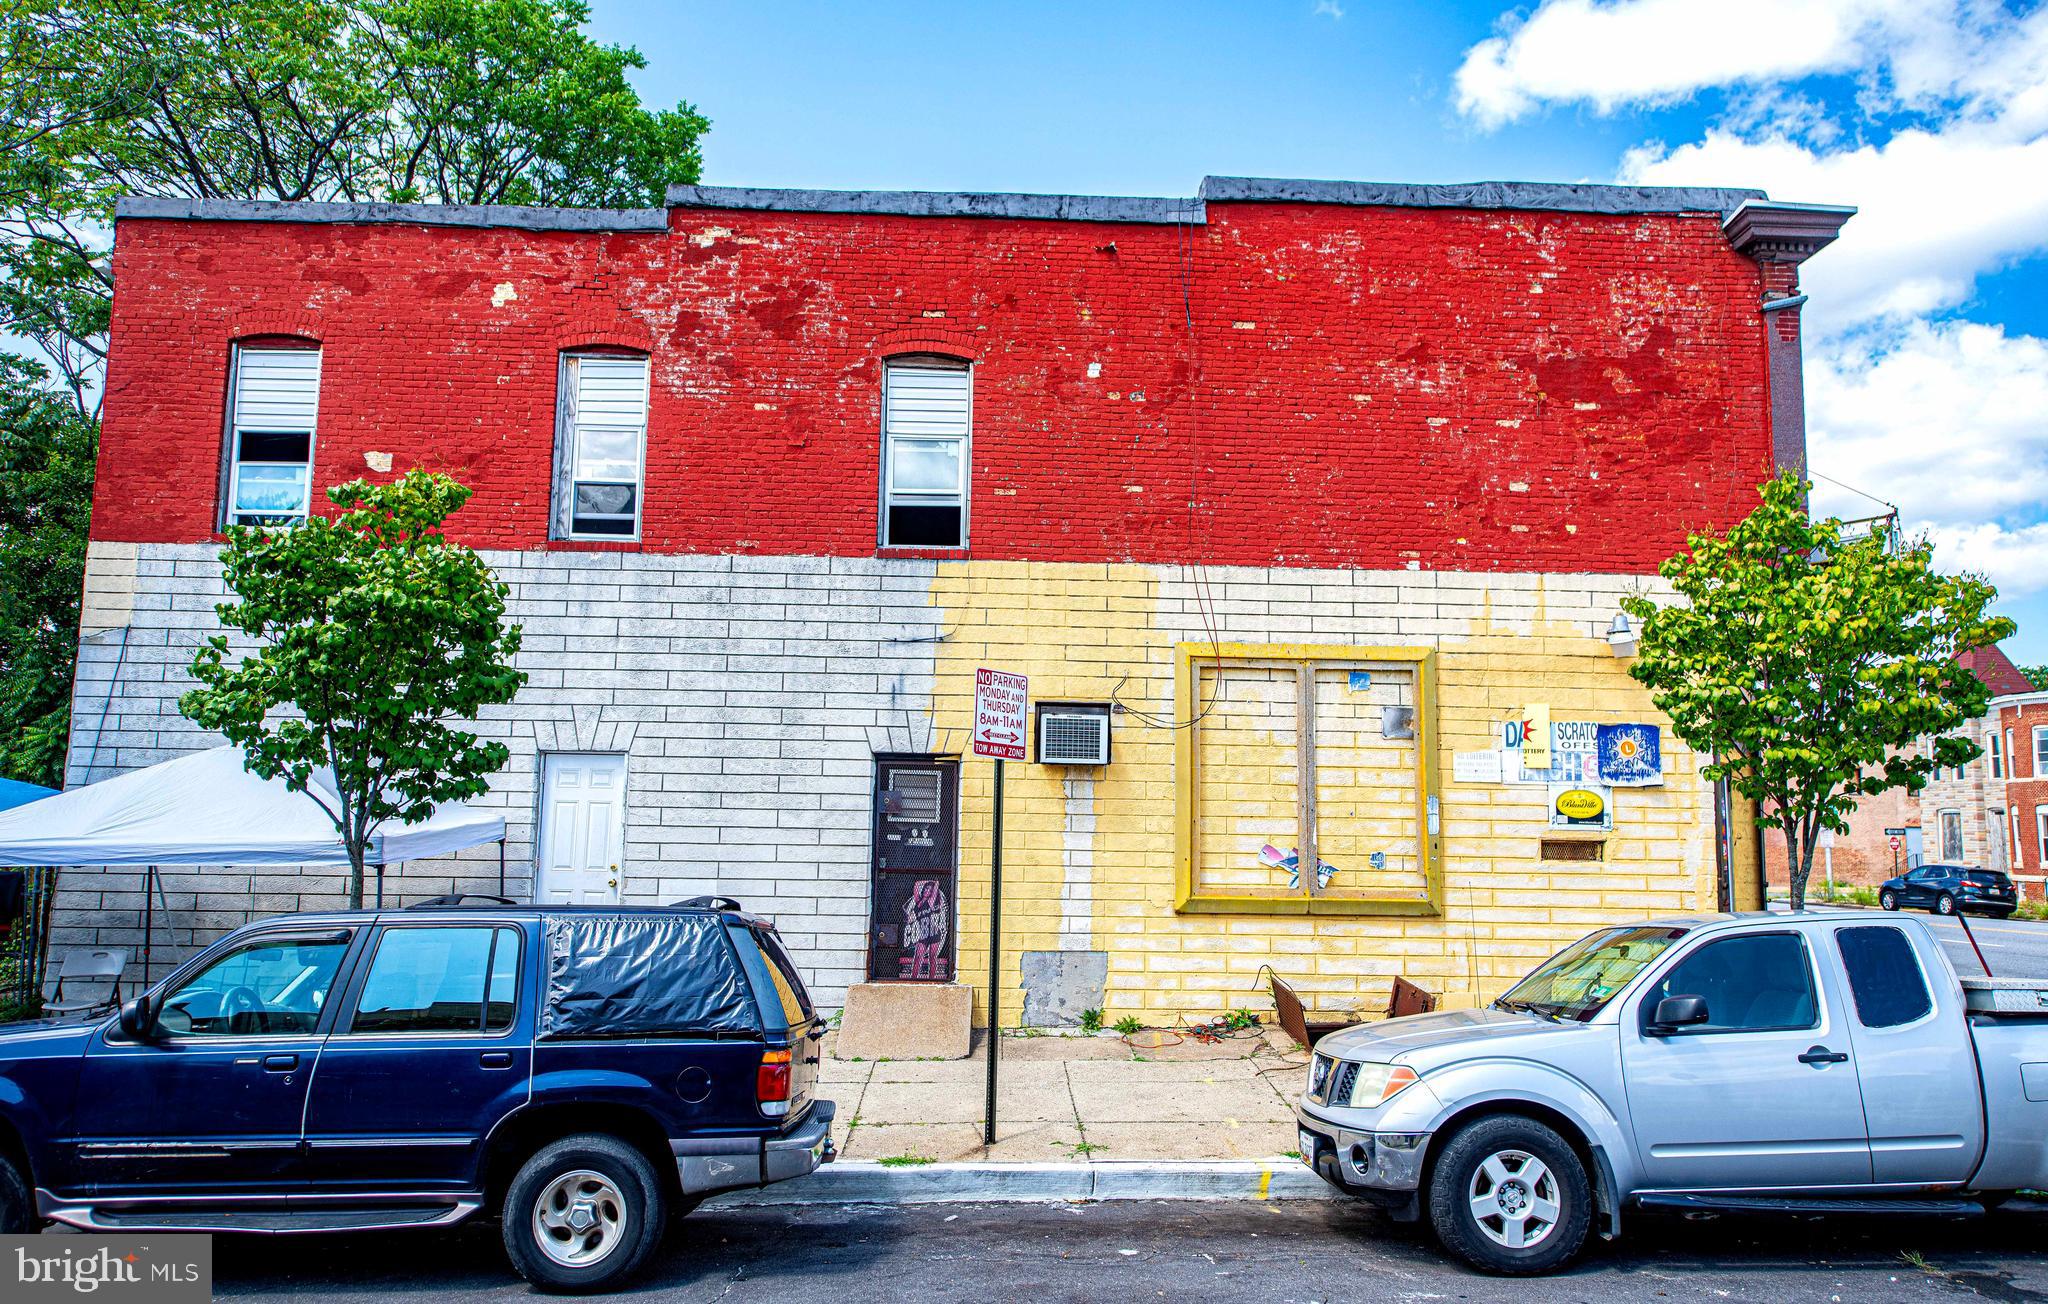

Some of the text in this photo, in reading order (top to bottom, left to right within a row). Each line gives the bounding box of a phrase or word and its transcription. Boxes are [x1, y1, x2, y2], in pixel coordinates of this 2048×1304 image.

[978, 671, 1026, 690] NO PARKING
[979, 685, 1024, 703] MONDAY AND
[983, 699, 1020, 715] THURSDAY
[1557, 722, 1598, 741] SCRATC
[975, 743, 1025, 757] TOW AWAY ZONE
